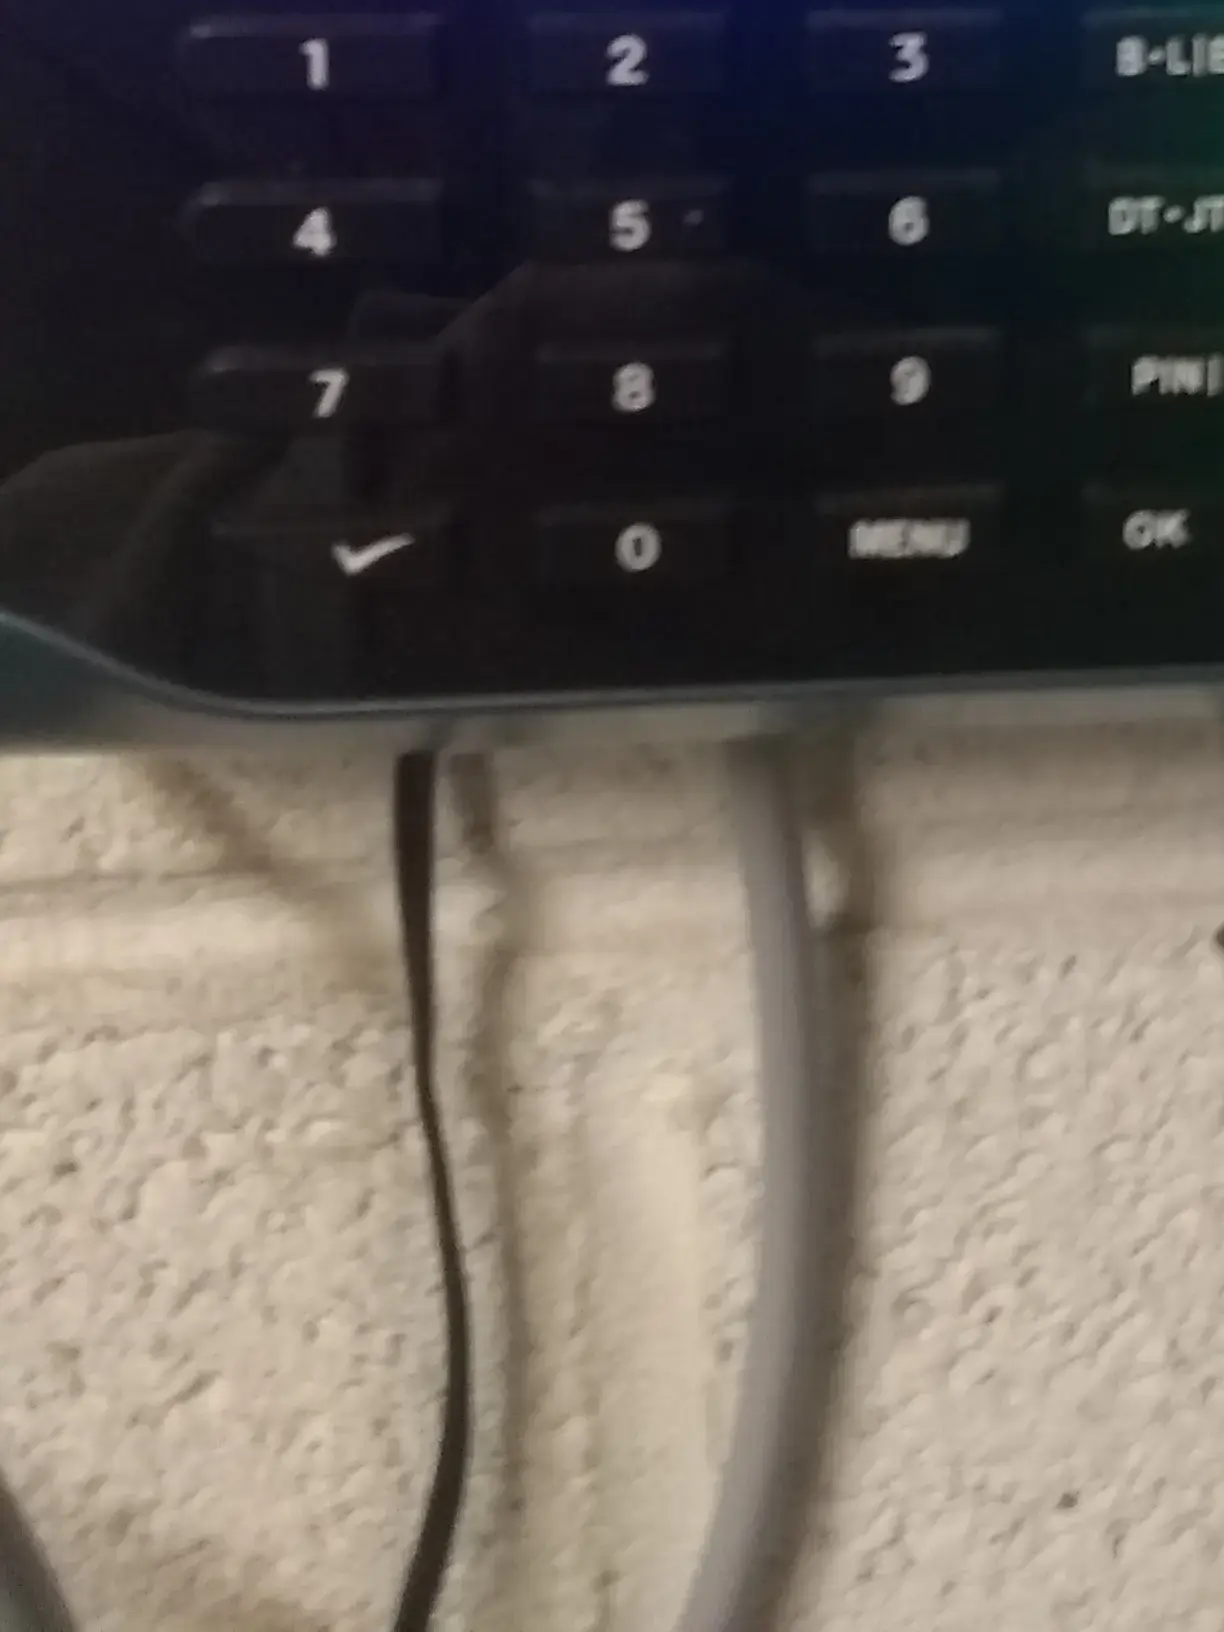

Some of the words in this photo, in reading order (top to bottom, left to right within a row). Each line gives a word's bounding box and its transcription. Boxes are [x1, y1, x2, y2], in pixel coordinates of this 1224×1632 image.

[301, 37, 330, 90] 1
[606, 34, 649, 86] 2
[888, 32, 929, 82] 3
[293, 207, 337, 256] 4
[609, 199, 651, 251] 5
[888, 195, 930, 246] 6
[309, 368, 349, 418] 7
[612, 362, 656, 413] 8
[889, 355, 932, 406] 9
[1122, 509, 1190, 550] OK
